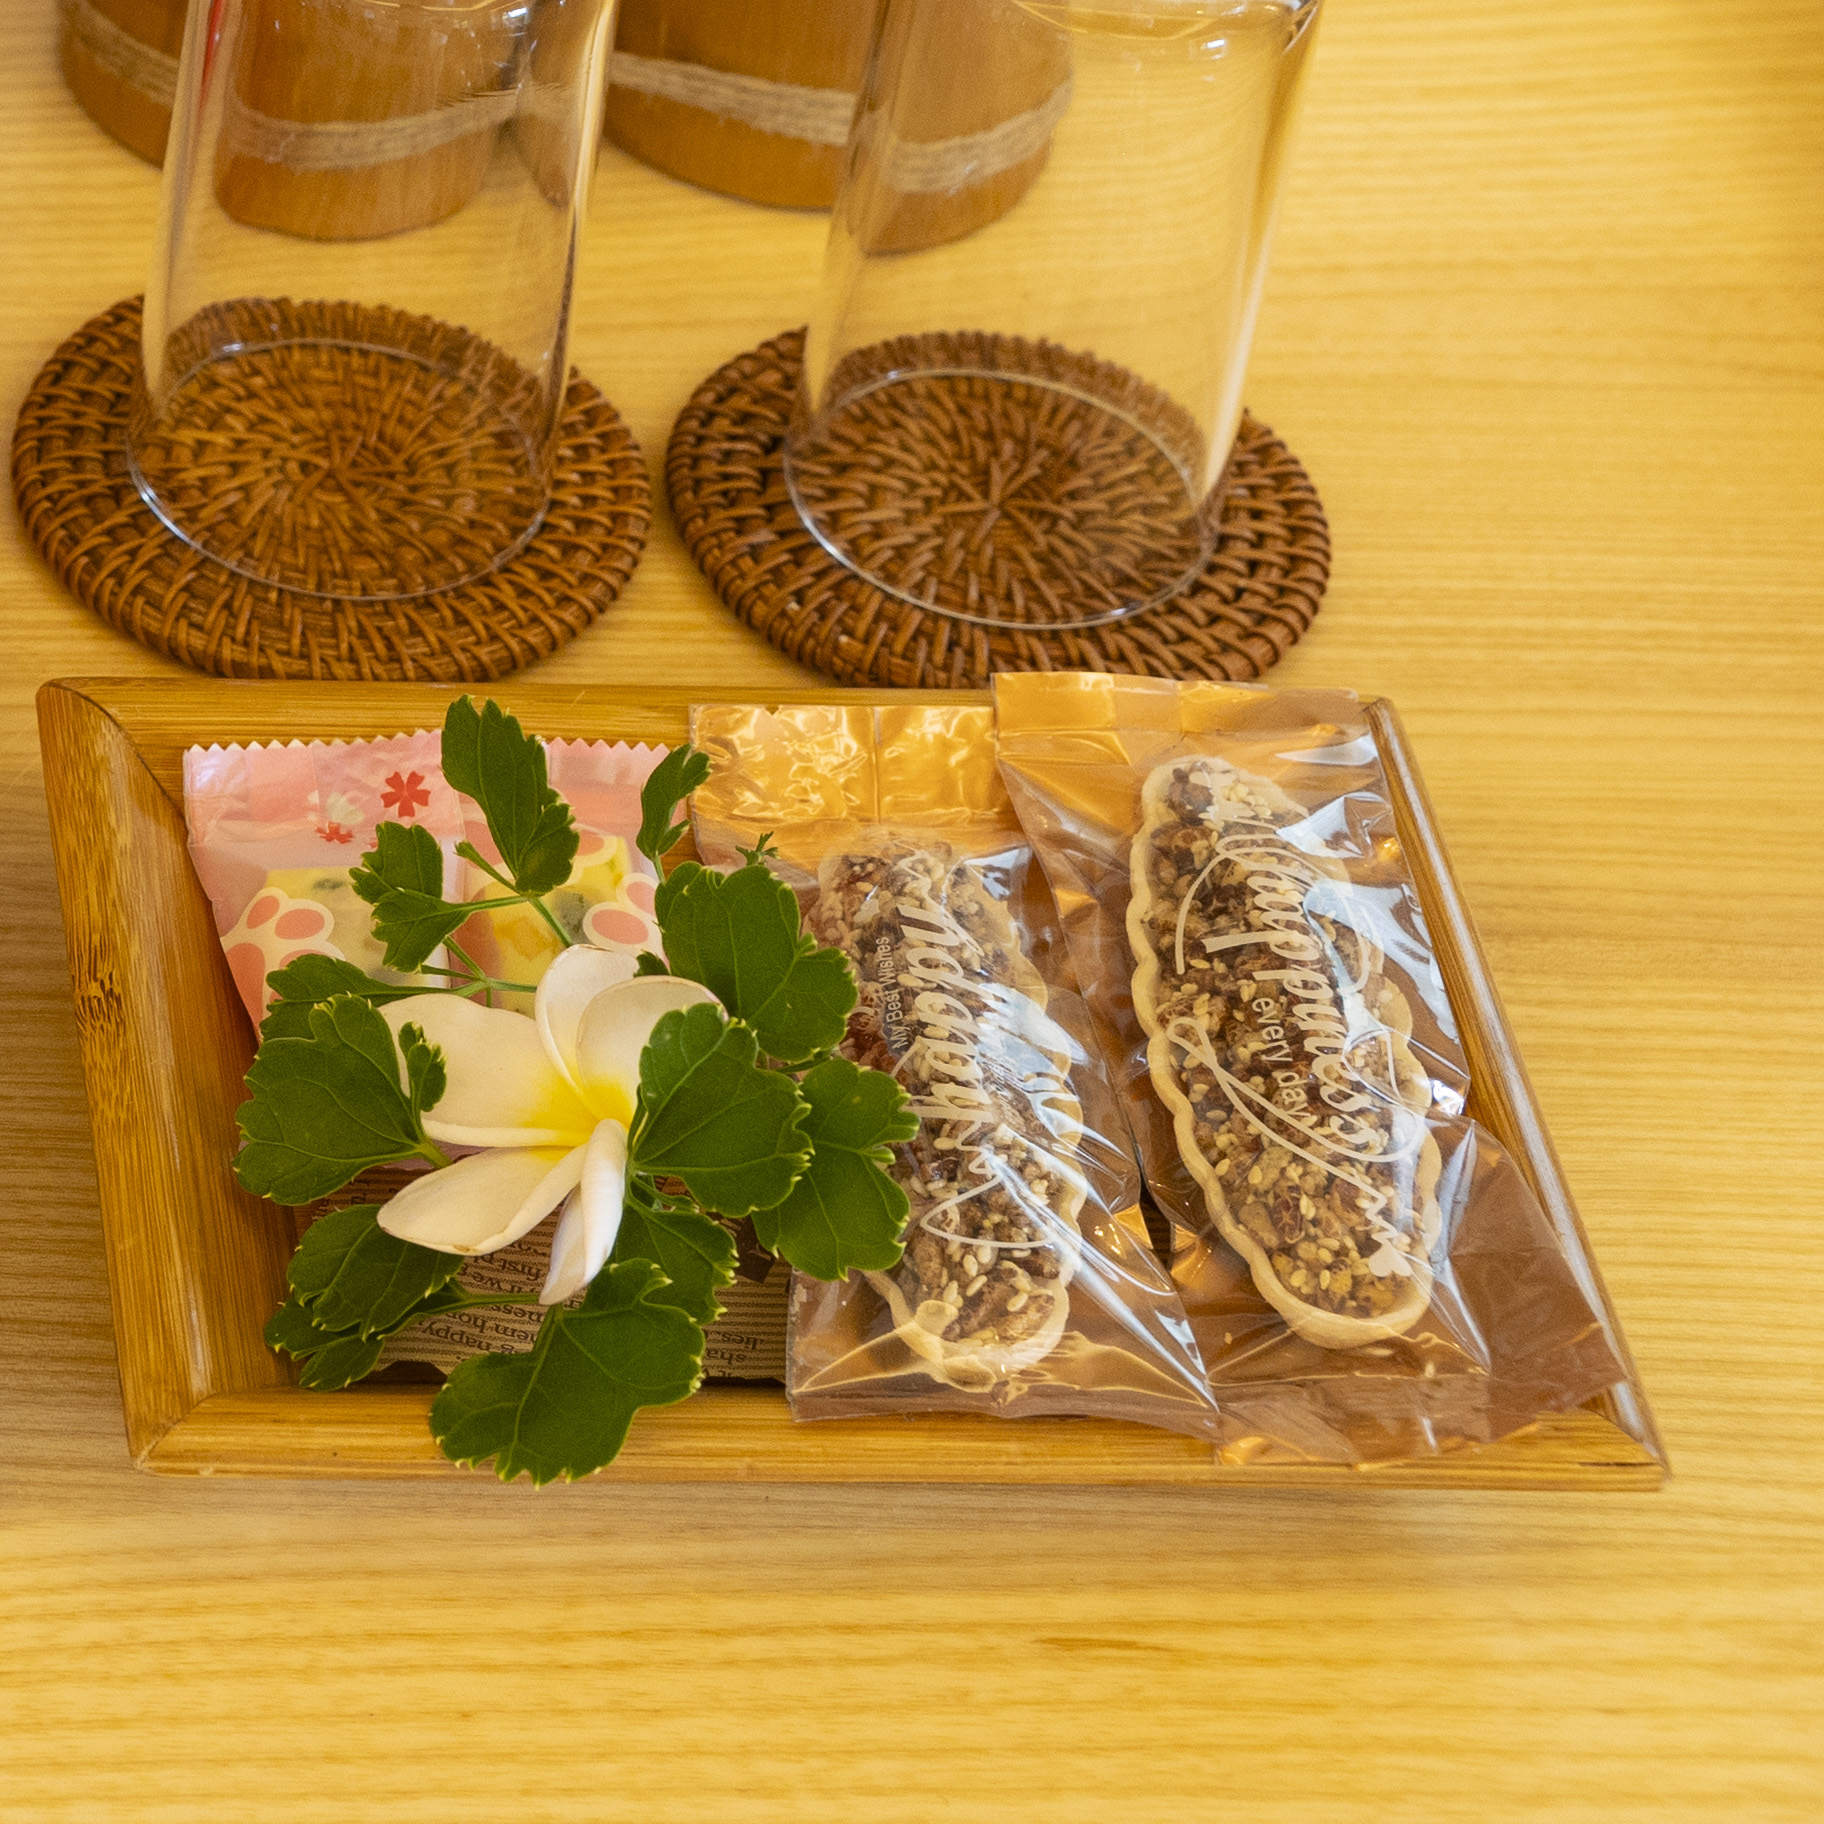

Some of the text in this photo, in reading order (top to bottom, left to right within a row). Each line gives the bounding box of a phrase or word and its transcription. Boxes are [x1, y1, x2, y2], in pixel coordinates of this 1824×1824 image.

[875, 937, 909, 1050] My Best Wishes
[1252, 997, 1311, 1119] every day
